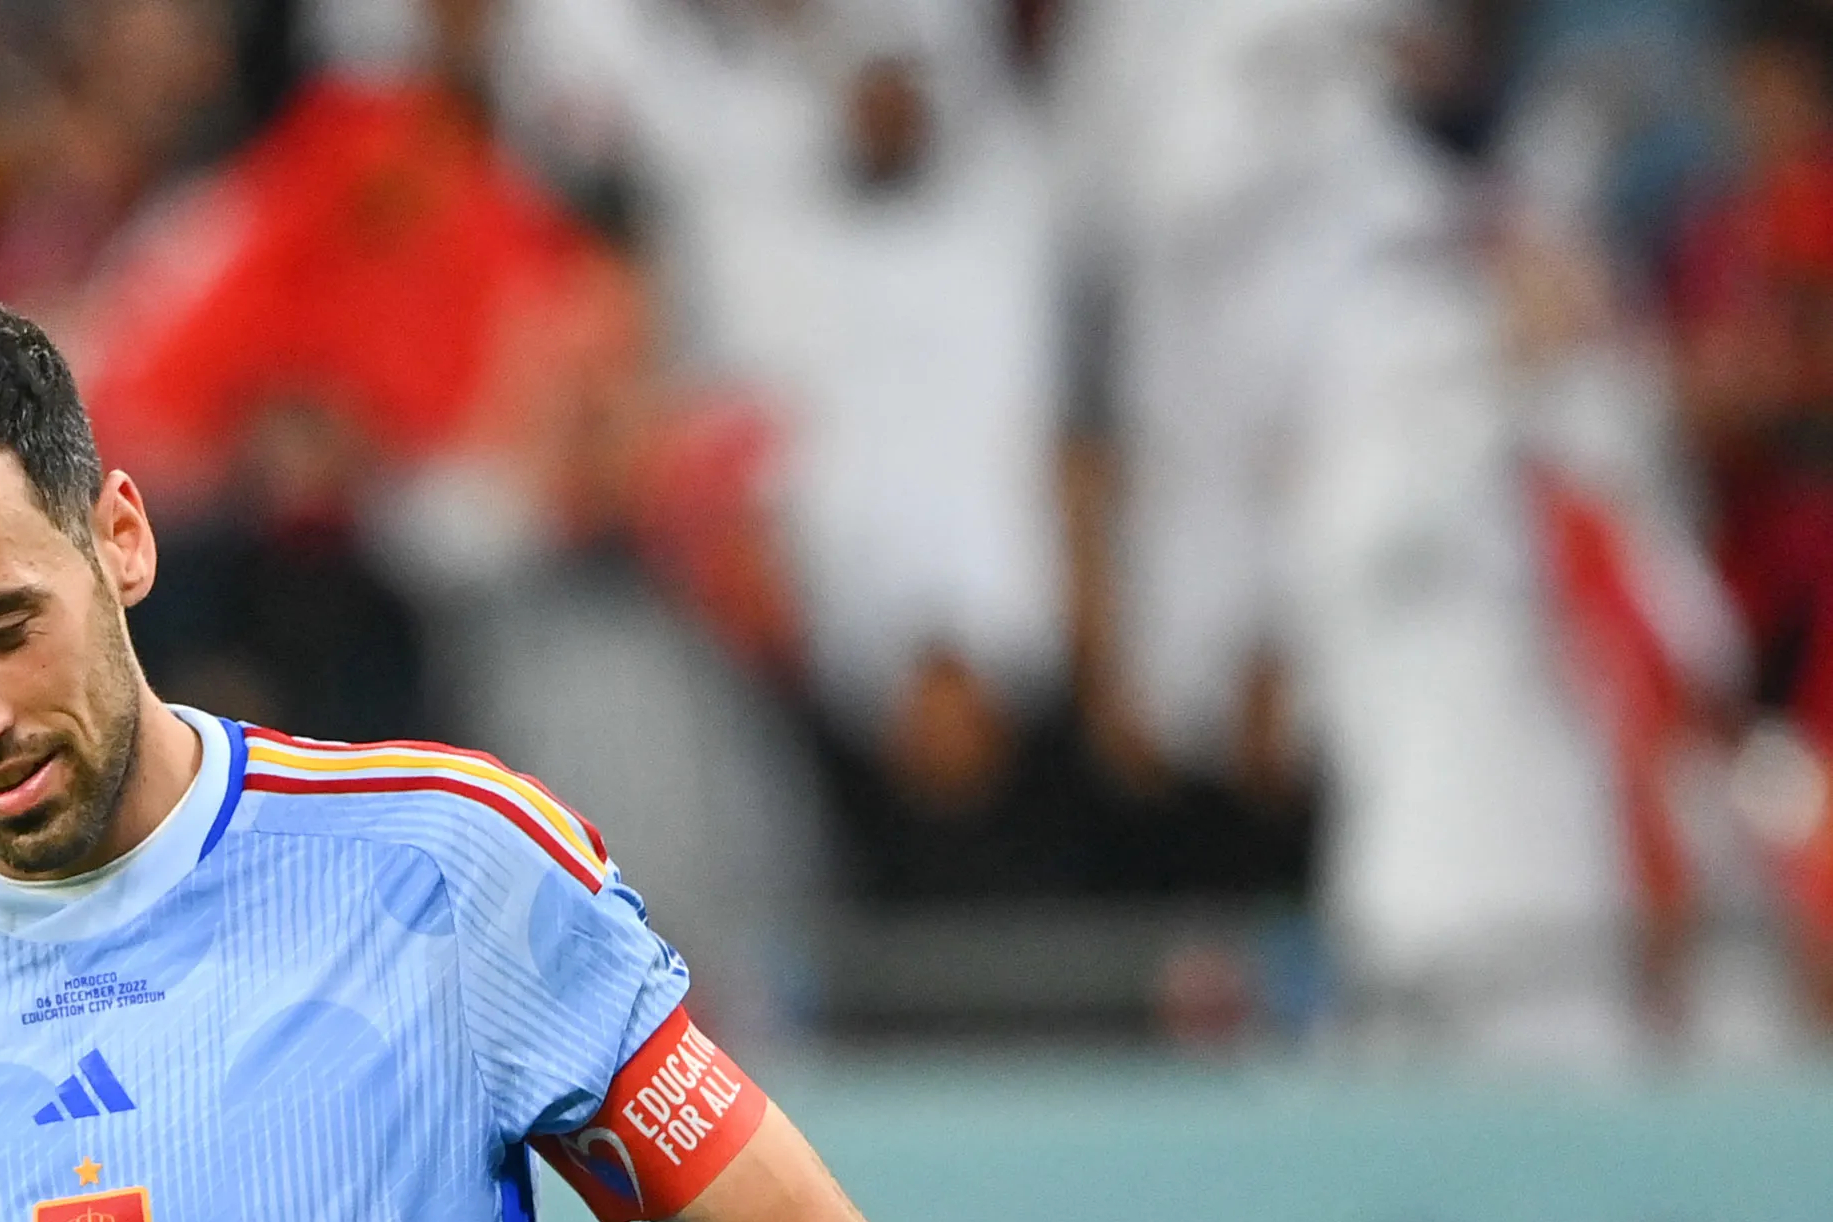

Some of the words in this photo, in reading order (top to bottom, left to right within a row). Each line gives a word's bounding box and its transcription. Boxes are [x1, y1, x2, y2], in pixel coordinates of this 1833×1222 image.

[36, 996, 52, 1009] 06
[55, 987, 115, 1007] DECEMBER
[118, 979, 148, 994] 2022
[64, 971, 118, 991] MOROCCO
[21, 1005, 85, 1026] EDUCATION
[89, 999, 113, 1014] CITY
[117, 991, 166, 1009] STADIUM
[655, 1104, 714, 1166] FOR
[698, 1065, 742, 1118] ALL
